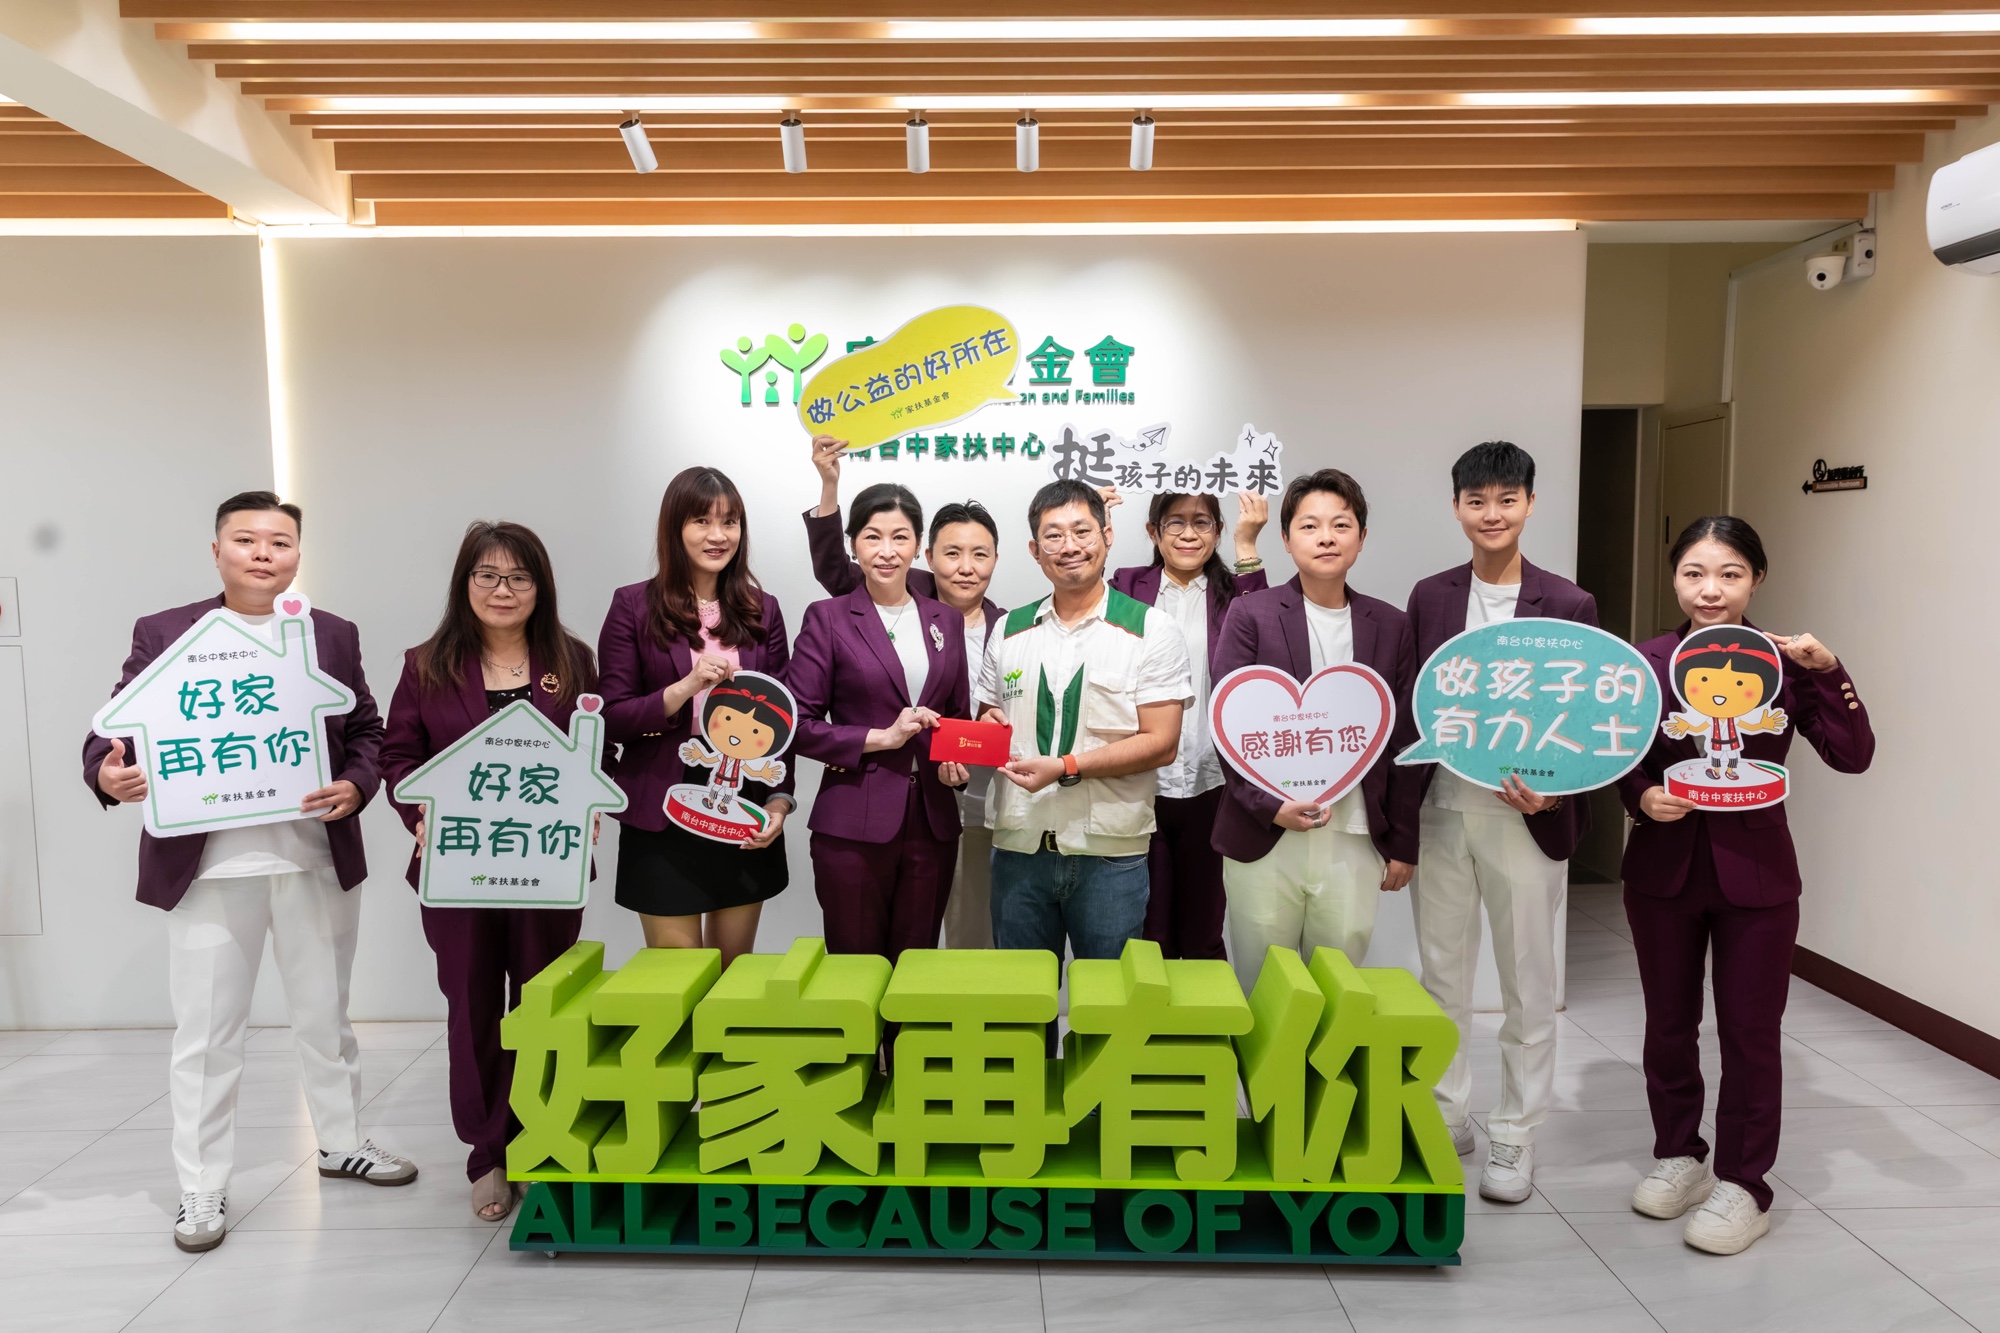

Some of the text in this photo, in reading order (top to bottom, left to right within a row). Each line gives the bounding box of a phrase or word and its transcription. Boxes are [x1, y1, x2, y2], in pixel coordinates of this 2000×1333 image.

[806, 328, 1011, 424] 做公益的好所在
[904, 391, 950, 415] 家扶基金會
[1042, 389, 1069, 404] and
[1075, 389, 1135, 404] Families
[1053, 427, 1279, 495] 挺孩子的未來
[187, 650, 258, 663] 南台中家扶中心
[1496, 635, 1584, 650] 南台中家扶中心
[1432, 654, 1647, 706] 做孩子的
[177, 673, 279, 721] 好家
[1273, 711, 1329, 723] 南台中家扶中心
[1431, 704, 1642, 756] 有力人士
[156, 727, 311, 780] 再有你
[485, 737, 551, 748] 南台中家扶中心
[1241, 725, 1368, 760] 感謝有您
[468, 762, 560, 804] 好家
[1292, 779, 1327, 788] 家扶基金會
[1512, 767, 1555, 778] 家扶基金會
[221, 788, 277, 803] 家扶基金會
[1687, 789, 1767, 803] 南台中家扶中心
[680, 810, 746, 838] 南台中家扶中心
[436, 816, 581, 861] 再有你
[488, 877, 541, 887] 家扶基金會
[501, 938, 1466, 1186] 好家再有你
[509, 1182, 1466, 1258] ALL BECAUSE OF YOU
